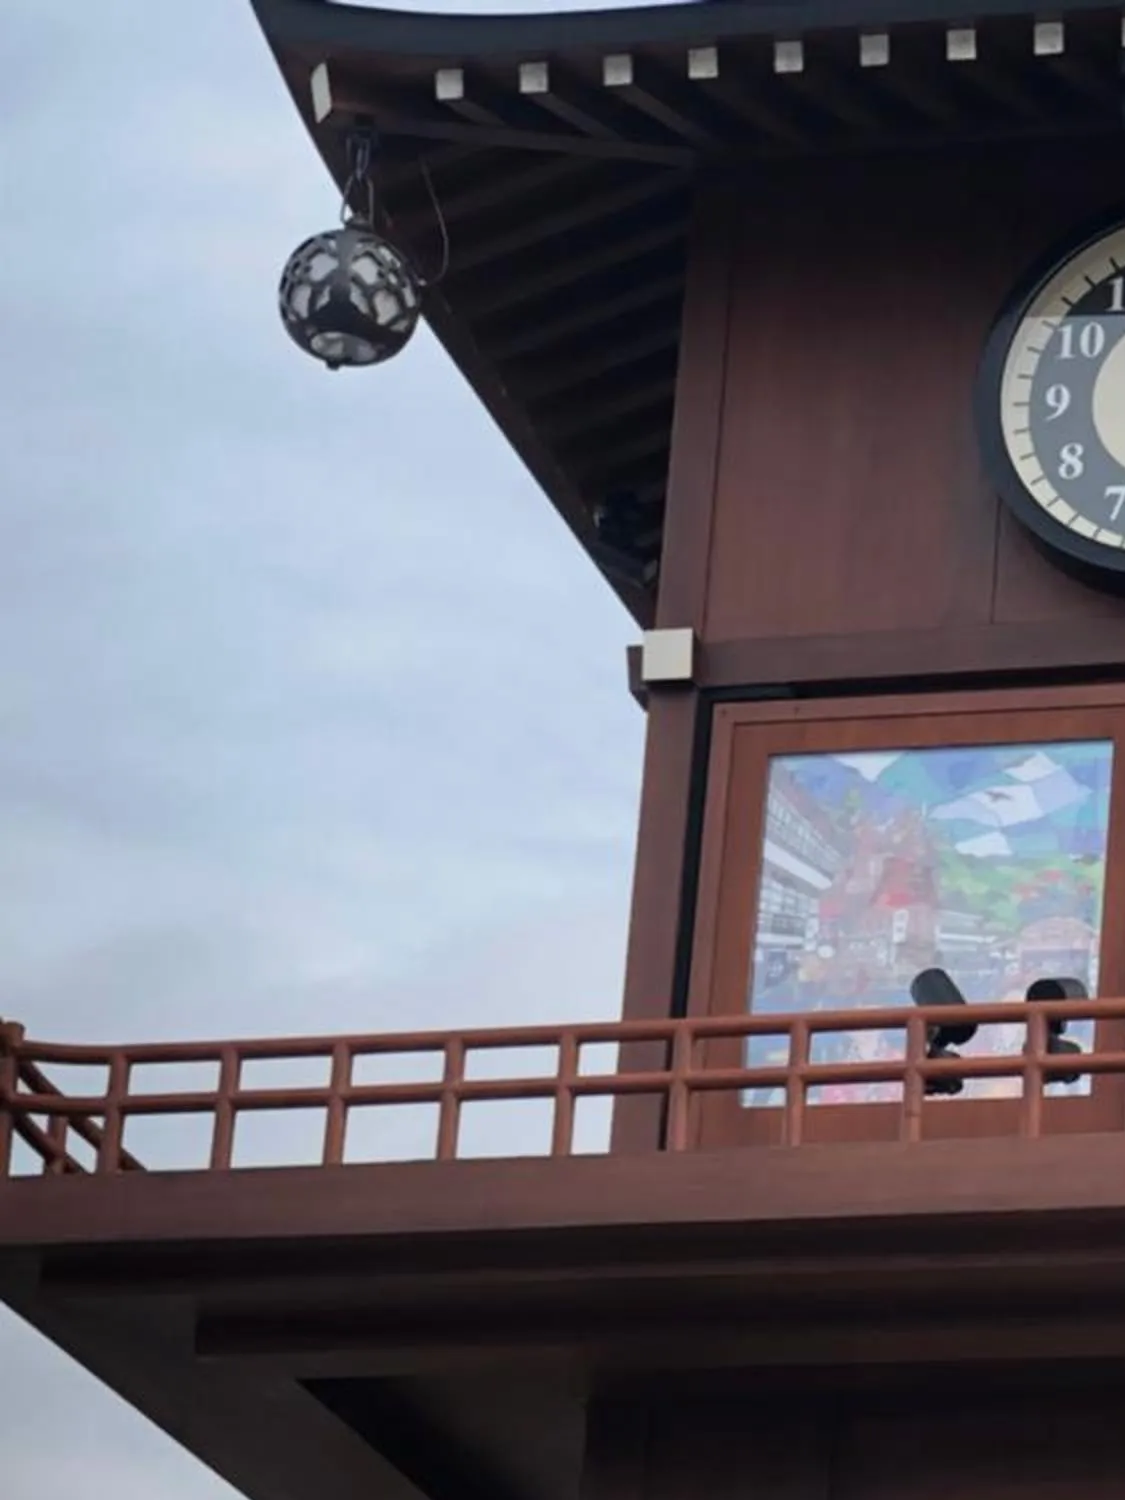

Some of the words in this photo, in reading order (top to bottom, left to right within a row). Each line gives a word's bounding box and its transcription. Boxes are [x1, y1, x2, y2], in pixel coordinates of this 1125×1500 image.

[1056, 321, 1105, 359] 10
[1045, 383, 1071, 420] 9
[1057, 442, 1085, 480] 8
